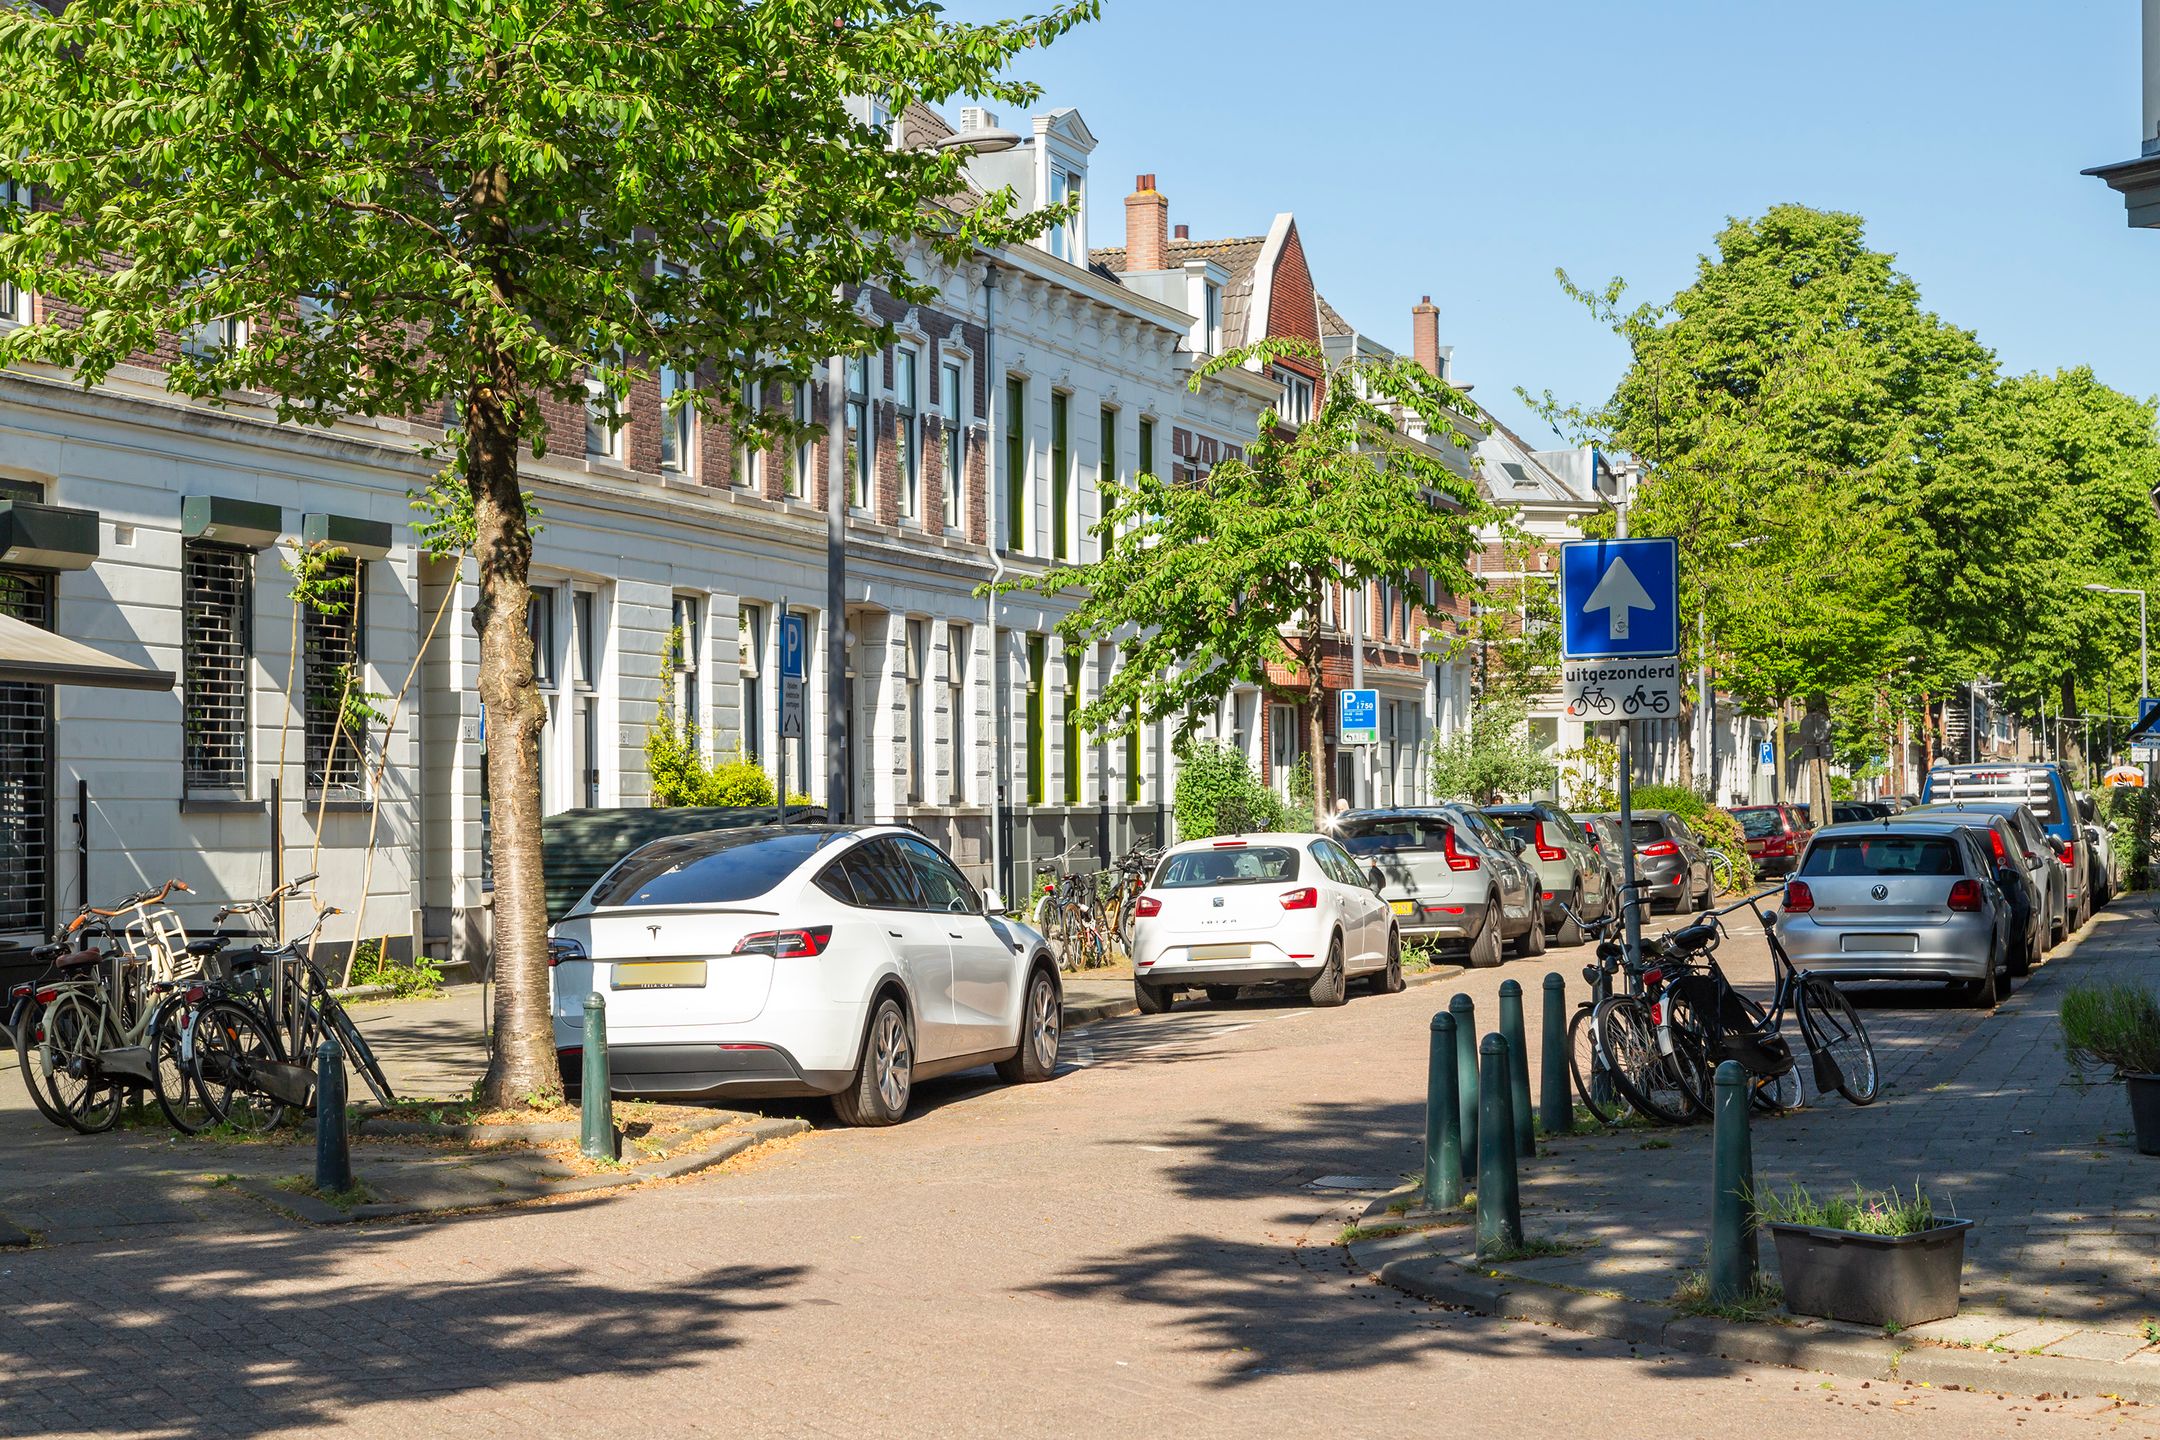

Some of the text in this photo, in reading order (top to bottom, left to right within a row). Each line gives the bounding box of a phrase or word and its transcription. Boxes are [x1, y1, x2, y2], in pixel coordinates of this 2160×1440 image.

[788, 624, 798, 667] P
[1566, 664, 1674, 685] uitgezonderd
[1344, 692, 1356, 709] P
[1763, 745, 1770, 755] P
